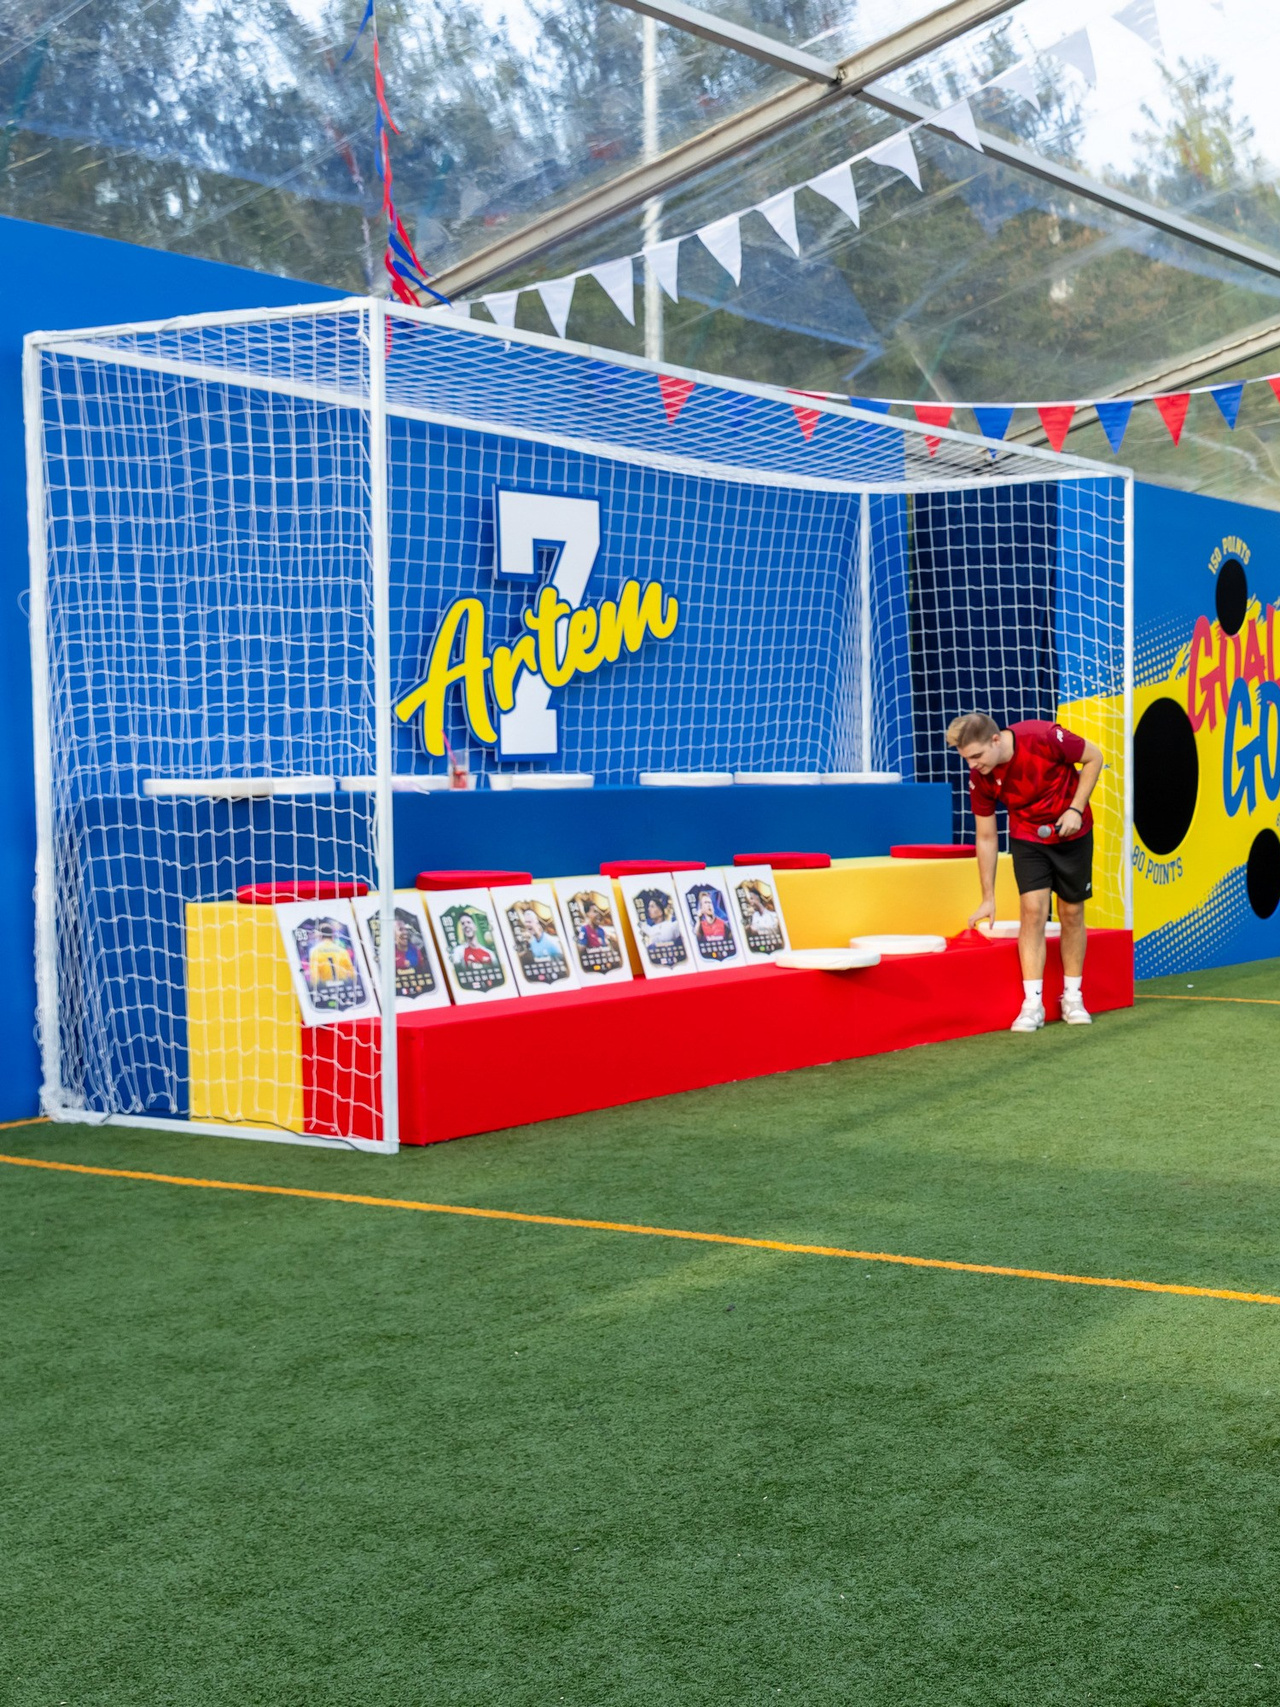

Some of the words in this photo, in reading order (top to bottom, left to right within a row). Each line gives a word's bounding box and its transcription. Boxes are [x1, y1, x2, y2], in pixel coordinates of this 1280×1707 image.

[1208, 547, 1222, 575] 150
[1222, 535, 1251, 565] POINTS
[394, 579, 679, 757] Artem
[499, 490, 600, 756] 7
[1132, 845, 1145, 872] 80
[1145, 857, 1183, 885] POINTS
